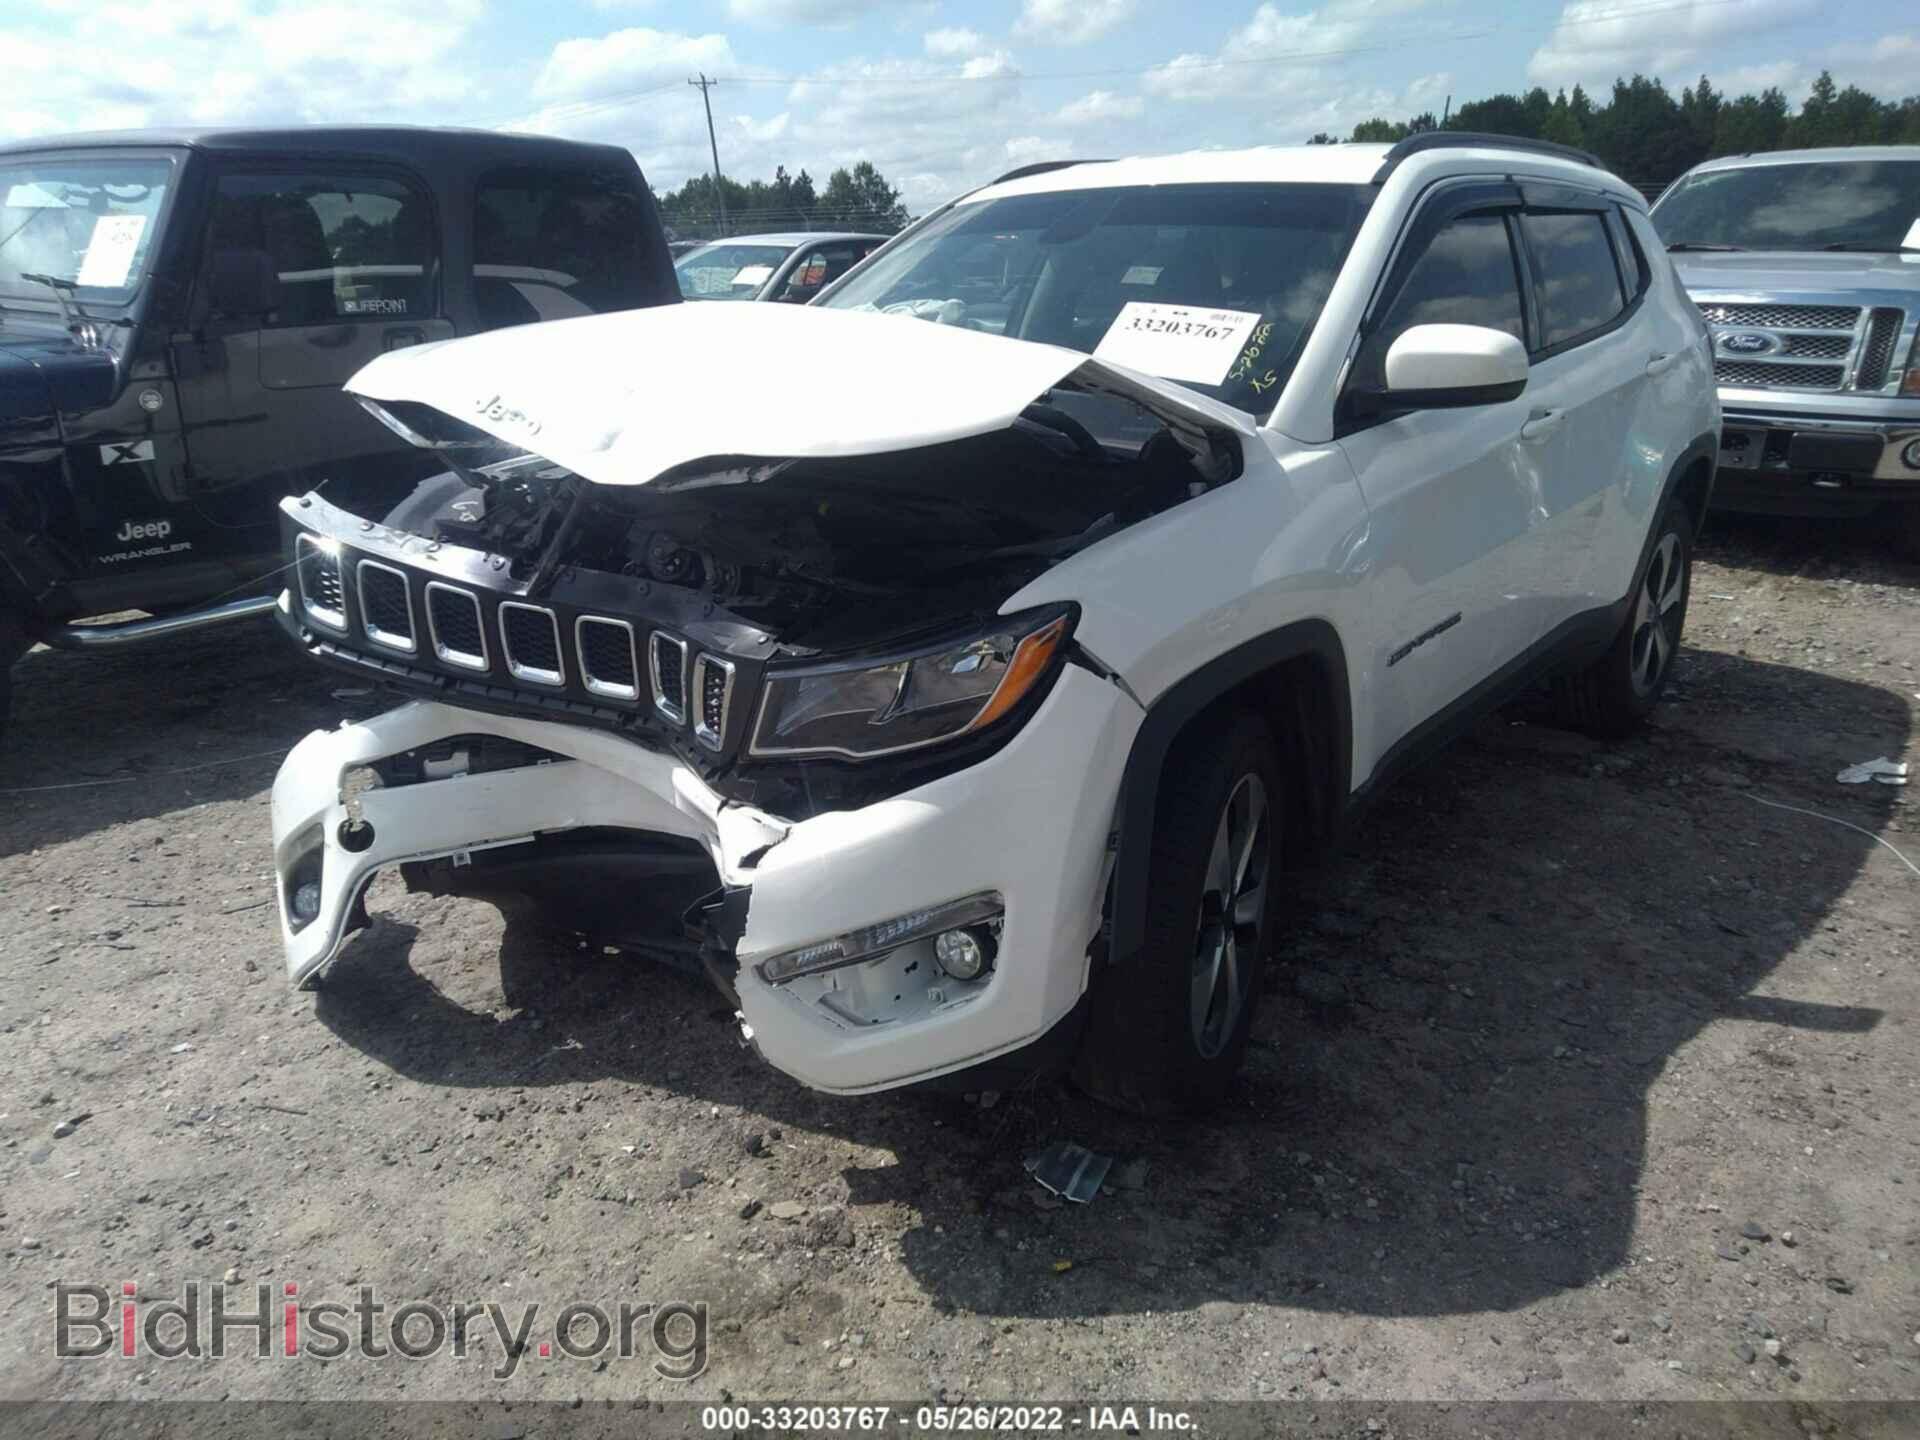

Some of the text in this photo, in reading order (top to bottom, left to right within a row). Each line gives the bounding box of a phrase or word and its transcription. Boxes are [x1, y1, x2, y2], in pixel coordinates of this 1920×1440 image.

[1124, 317, 1235, 340] 33203767
[1729, 335, 1763, 349] Ford
[117, 520, 171, 541] Jeep
[98, 541, 192, 564] WRANGLER
